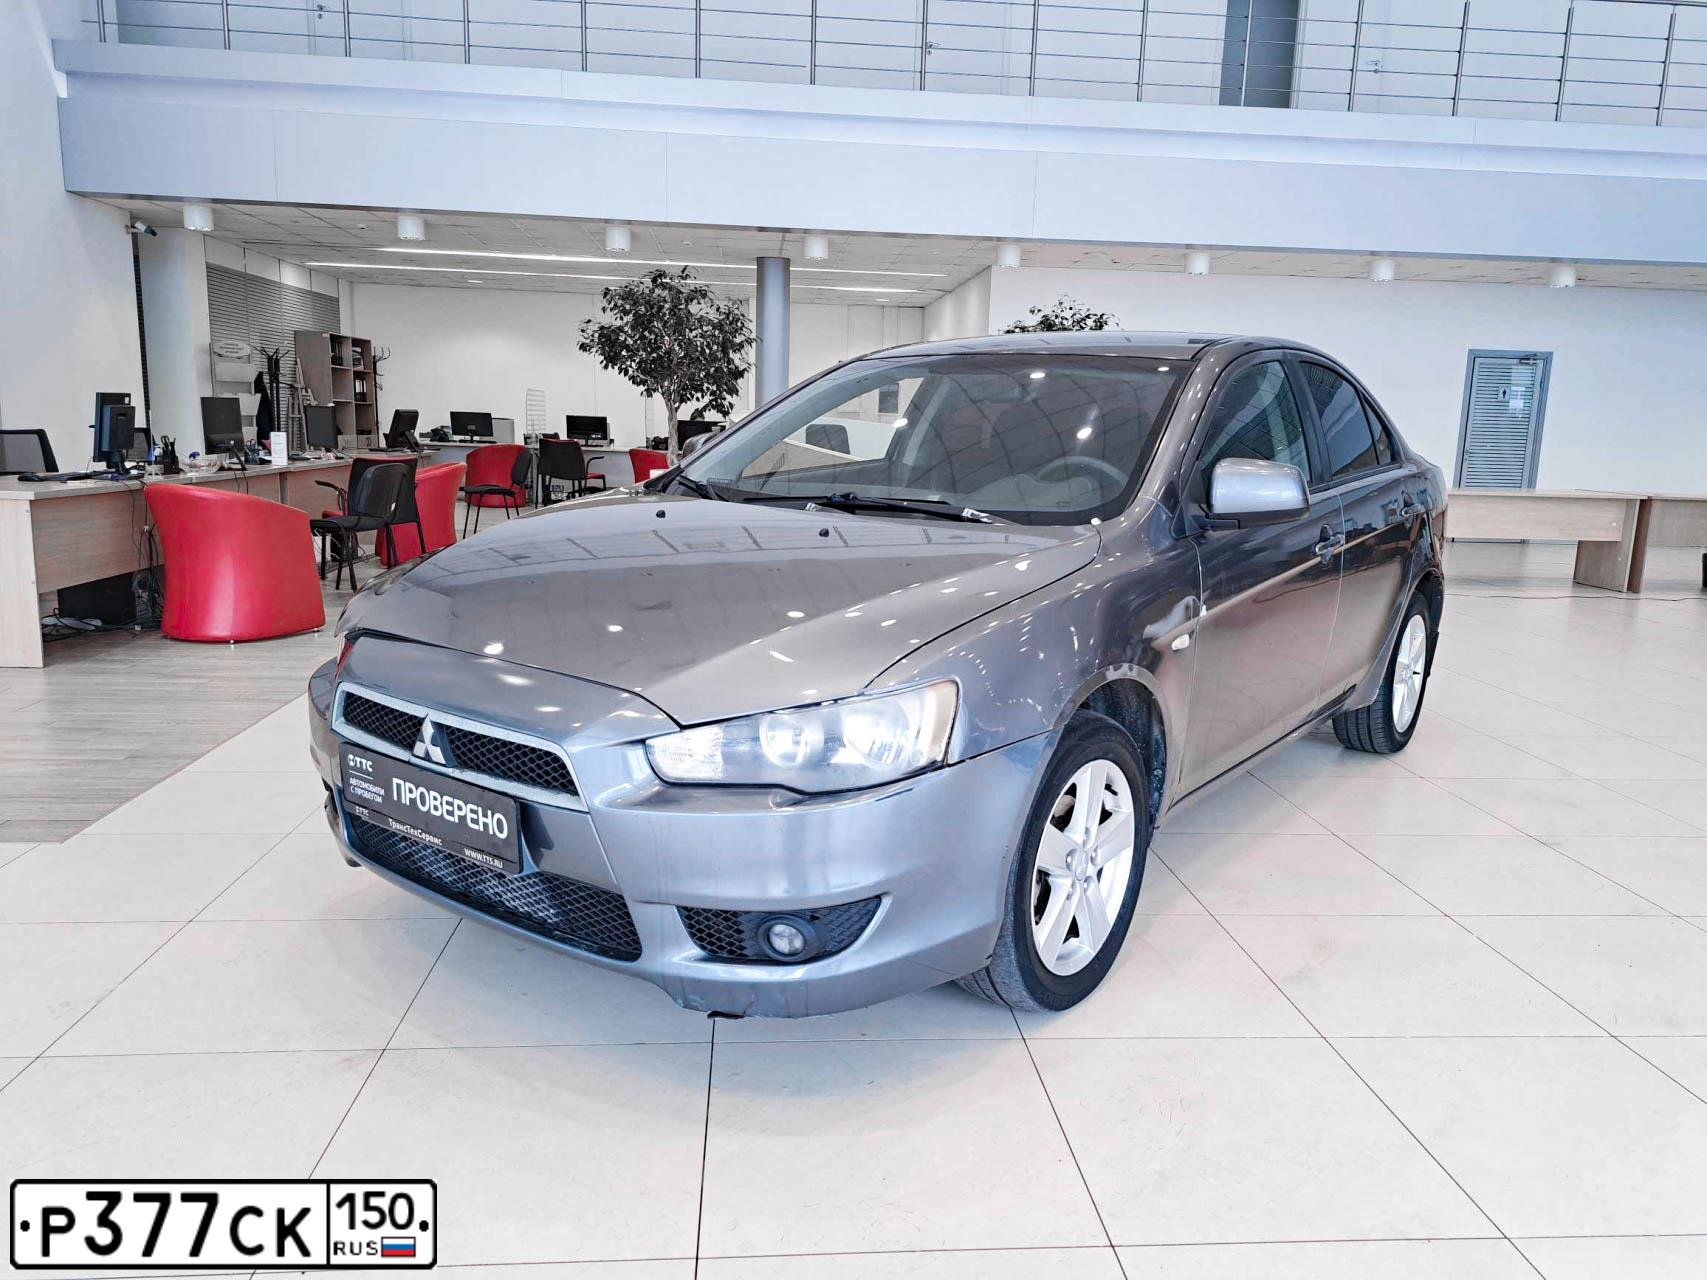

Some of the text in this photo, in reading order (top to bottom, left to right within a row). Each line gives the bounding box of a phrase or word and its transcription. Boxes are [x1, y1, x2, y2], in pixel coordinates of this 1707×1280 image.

[350, 778, 385, 796] АВТОМОБИЛИ
[355, 787, 383, 804] ПРОБЕГОМ
[392, 778, 509, 839] ПРОВЕРЕНО
[388, 818, 443, 846] ТрансТехСервис
[464, 848, 503, 868] WWW.TTS.RU
